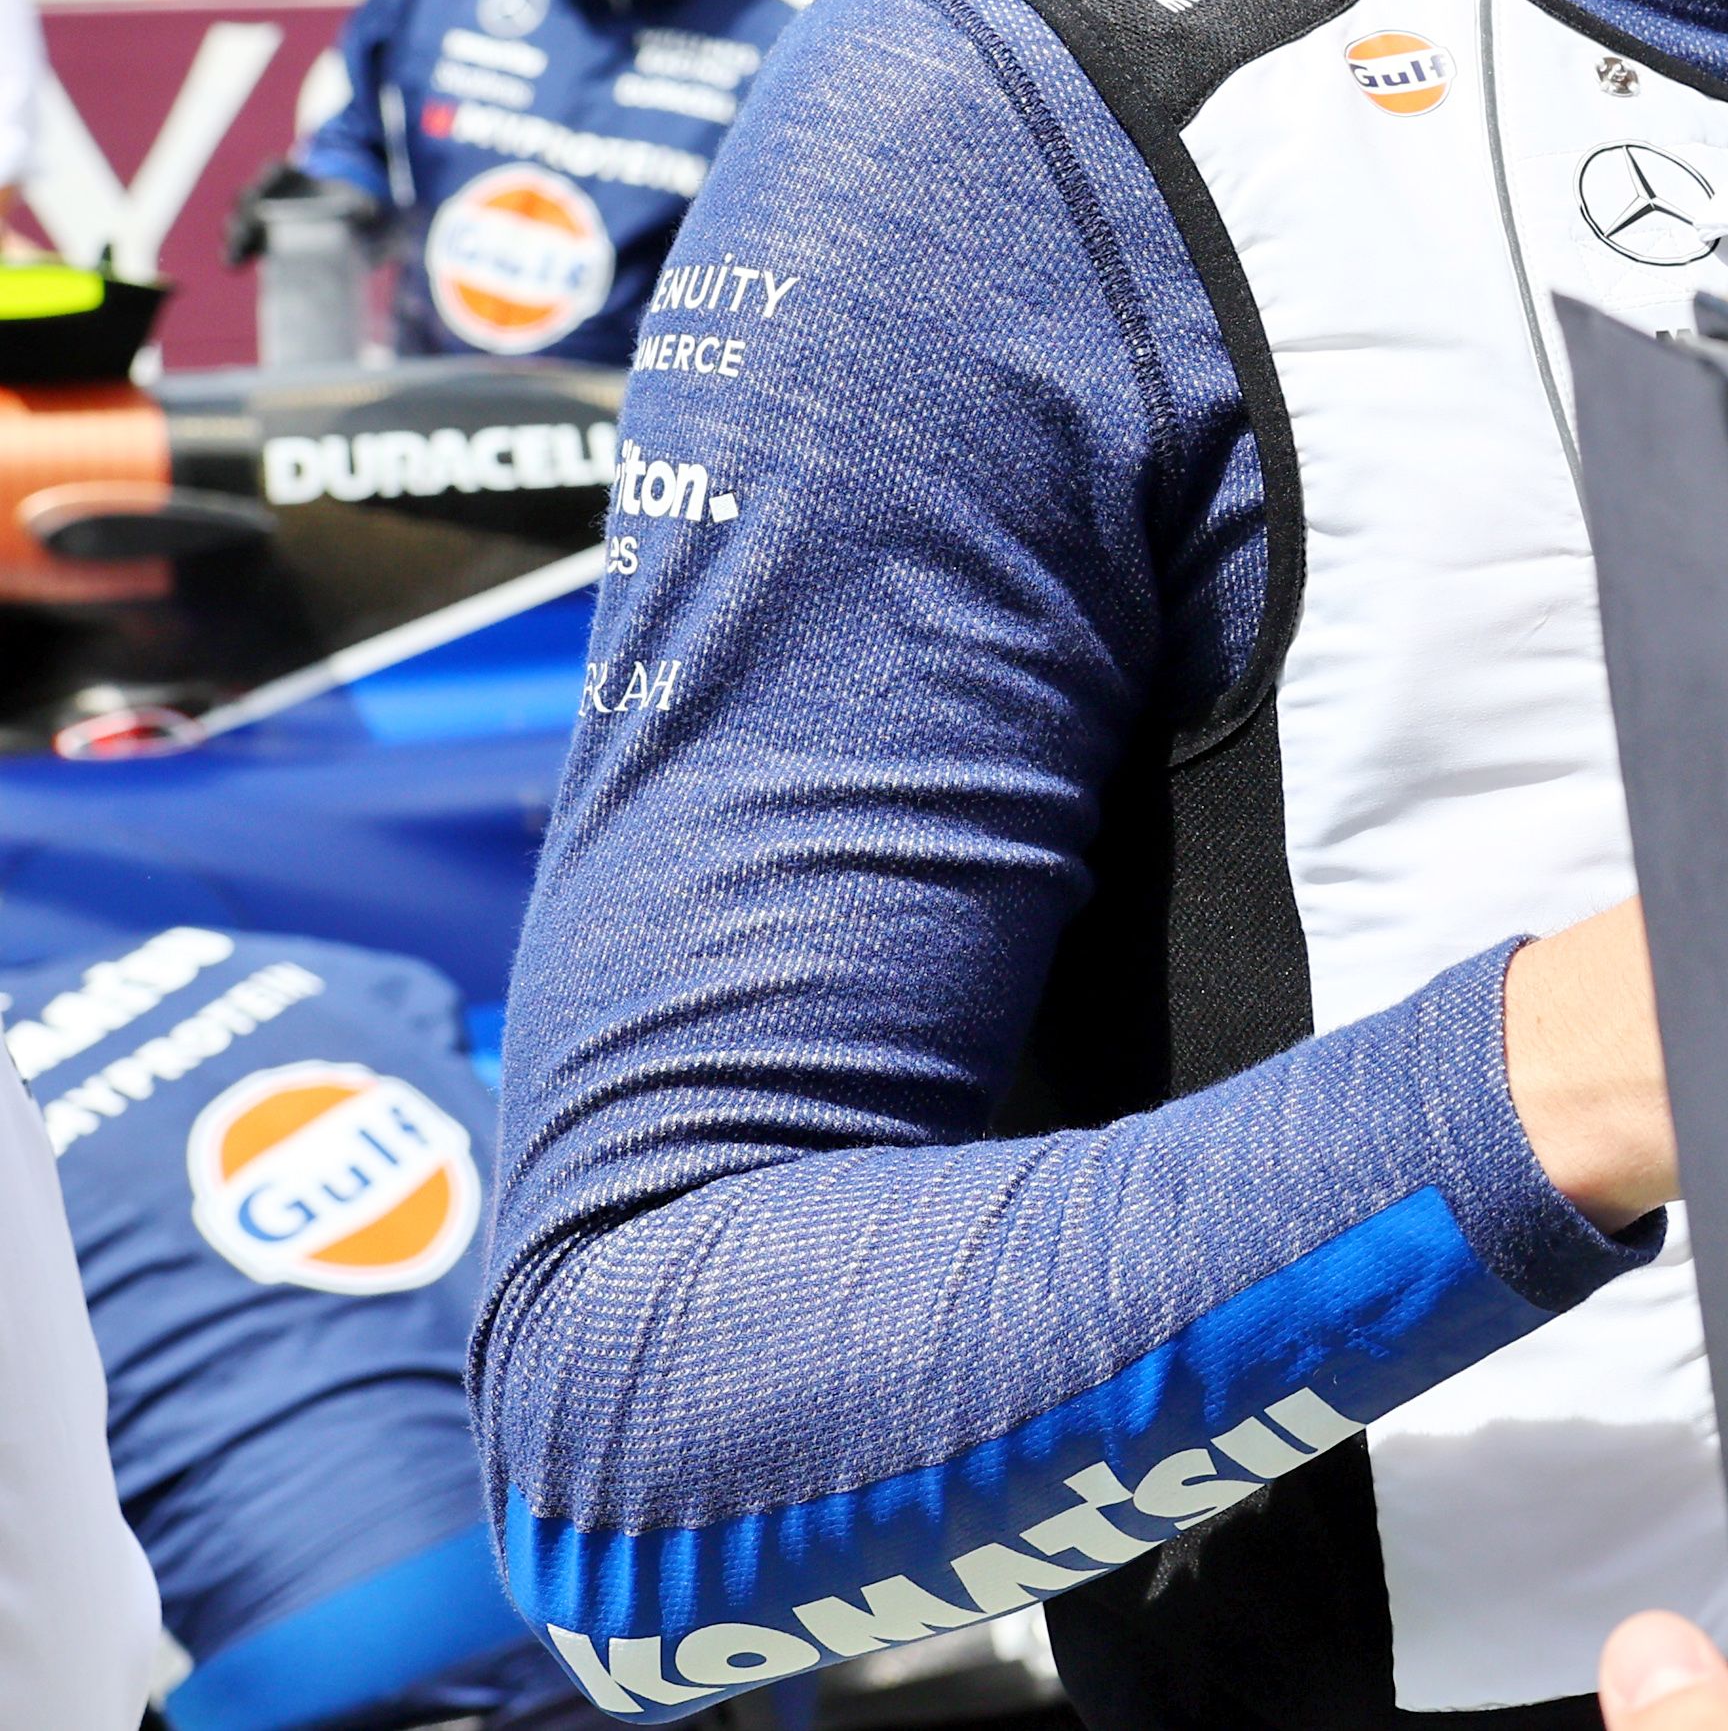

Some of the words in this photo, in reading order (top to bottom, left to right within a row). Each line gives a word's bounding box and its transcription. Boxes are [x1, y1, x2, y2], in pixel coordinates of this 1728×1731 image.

[1349, 53, 1447, 88] Gulf
[237, 1105, 430, 1244] Gulf
[547, 1386, 1368, 1714] KOMATSU
